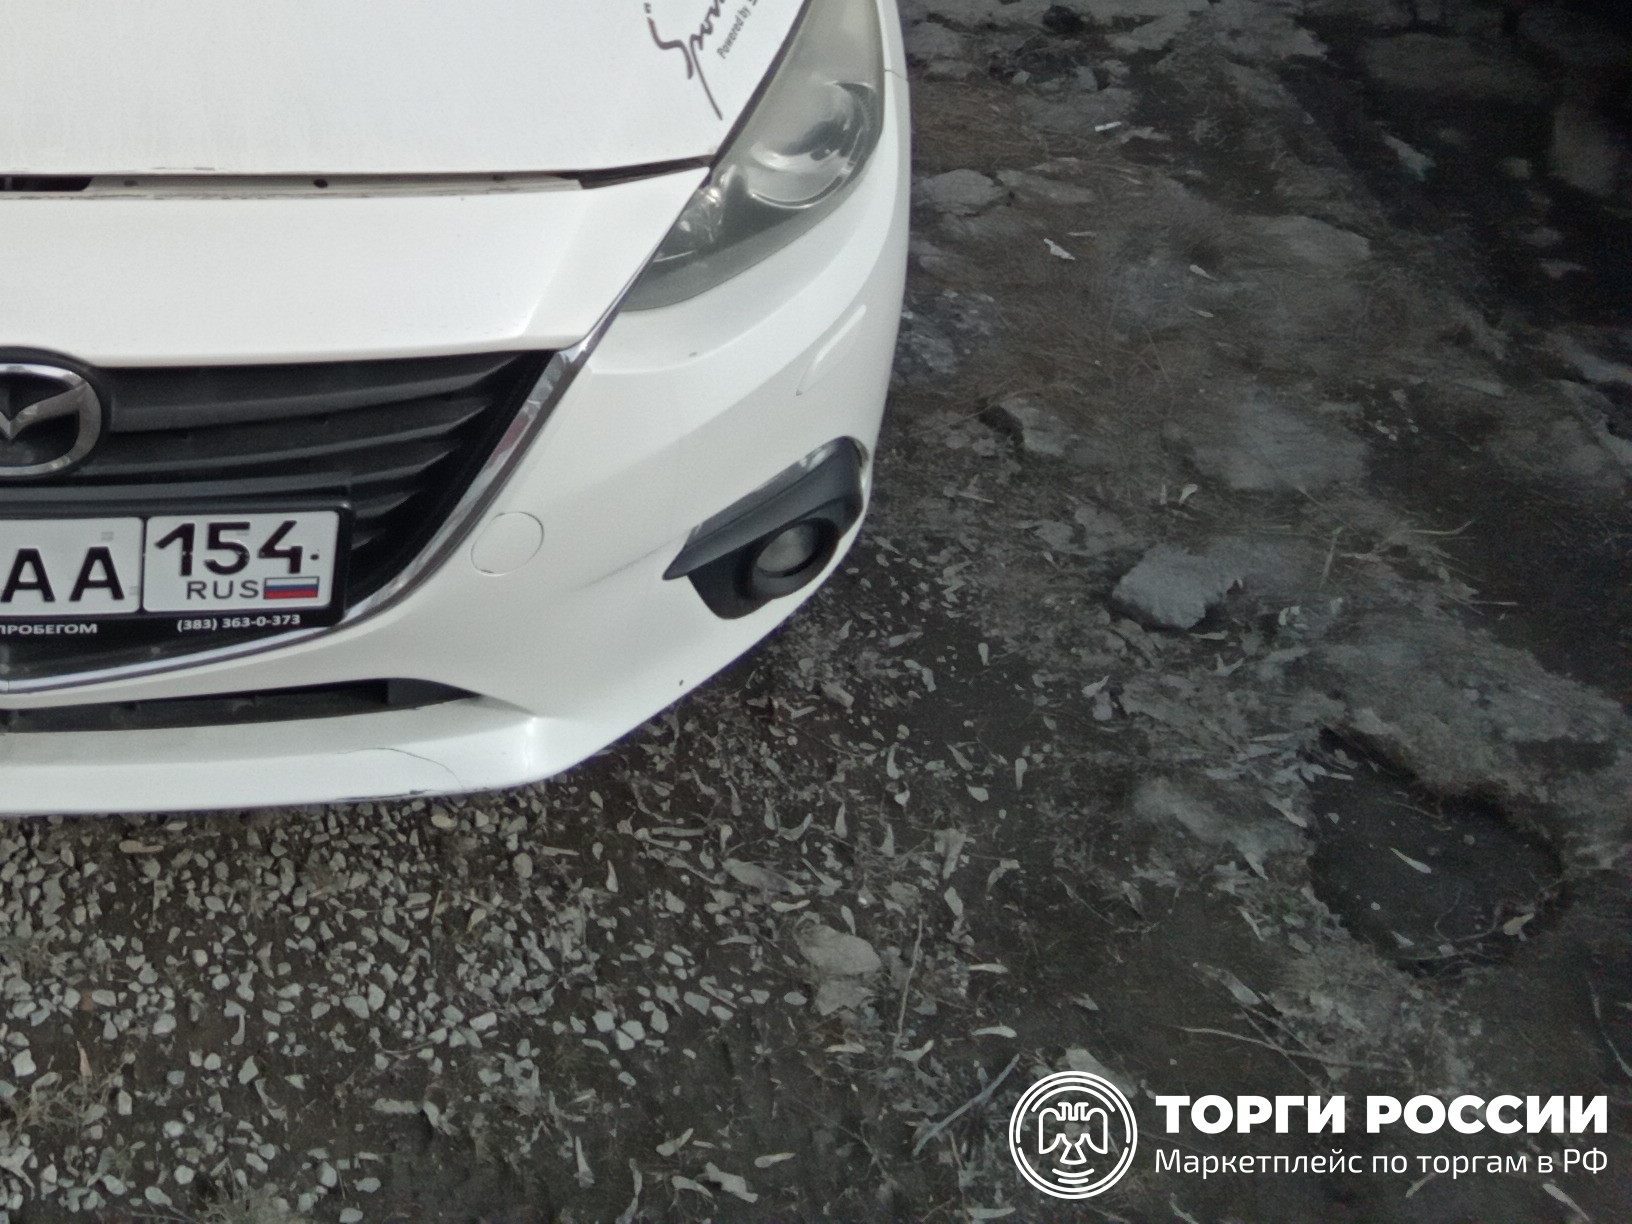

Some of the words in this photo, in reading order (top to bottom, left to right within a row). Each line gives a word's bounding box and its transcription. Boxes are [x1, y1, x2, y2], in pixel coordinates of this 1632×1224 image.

[716, 15, 745, 59] Powered
[153, 519, 305, 577] 154
[185, 579, 260, 601] RUS
[176, 618, 218, 633] (383)
[221, 613, 301, 629] 363-0-373
